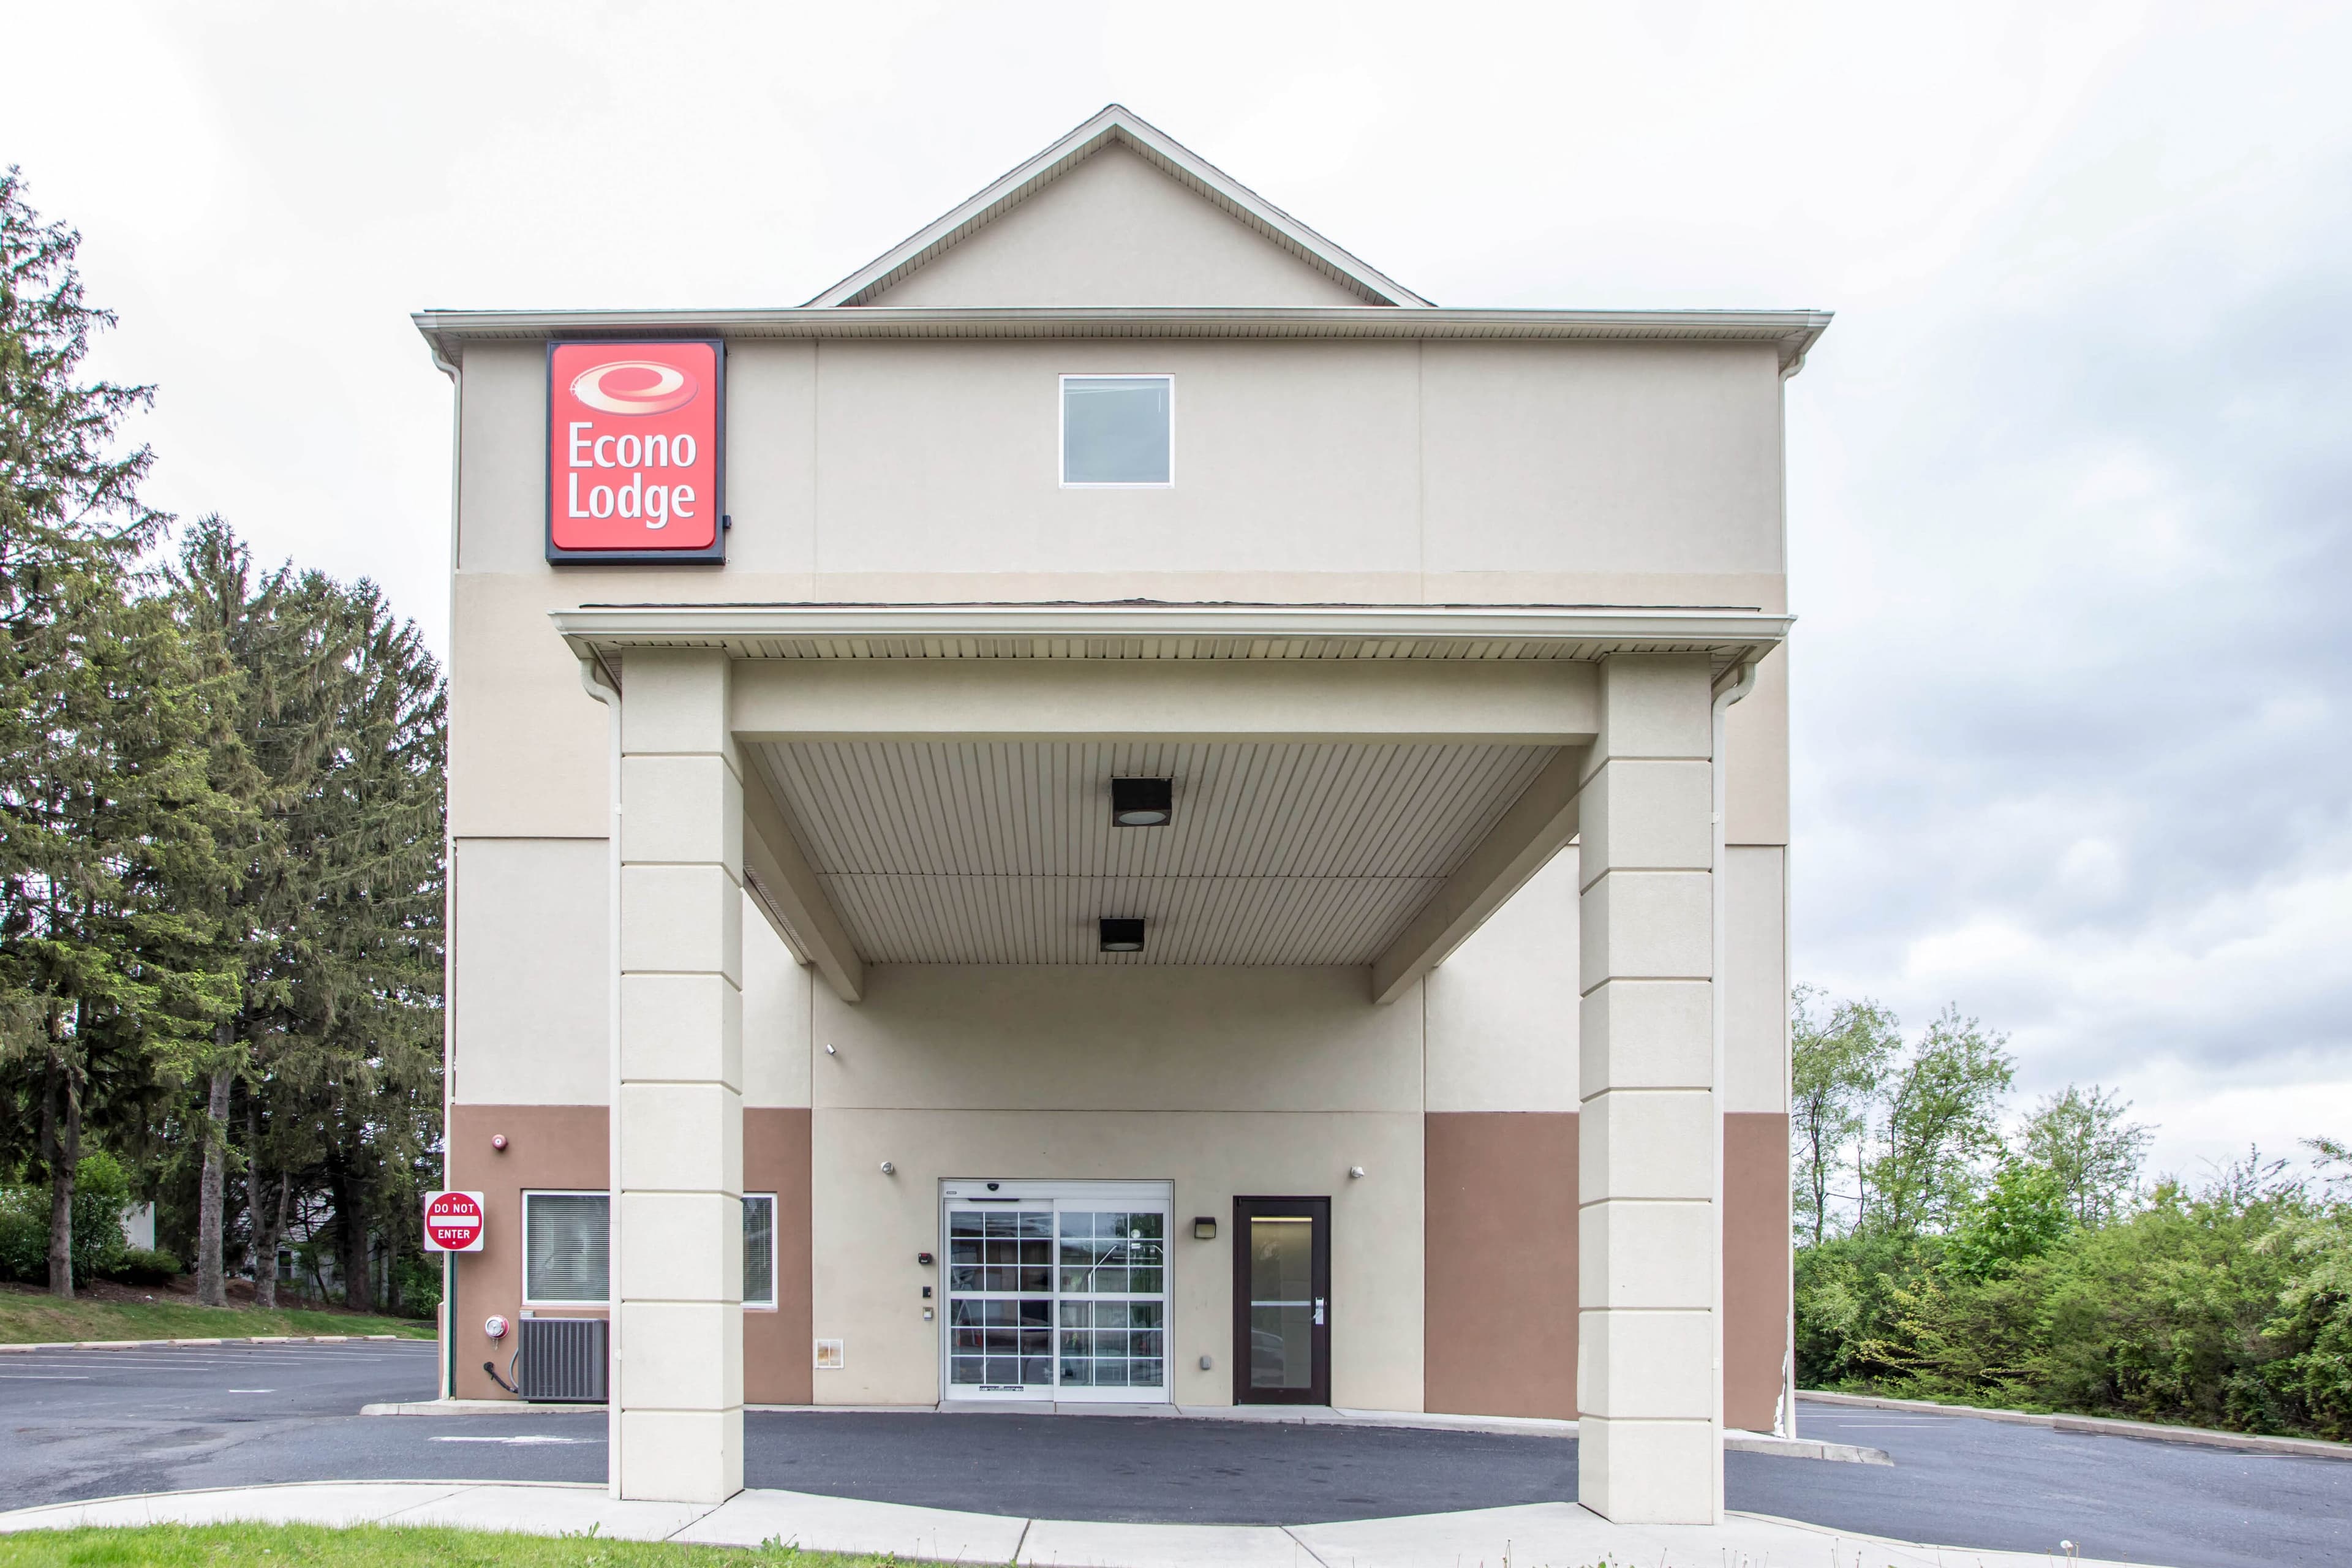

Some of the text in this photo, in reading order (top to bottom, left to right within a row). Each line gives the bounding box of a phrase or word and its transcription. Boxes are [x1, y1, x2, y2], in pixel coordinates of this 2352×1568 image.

[569, 421, 697, 467] Econo
[568, 472, 696, 529] Lodge
[434, 1204, 474, 1213] DO NOT
[438, 1229, 470, 1238] ENTER
